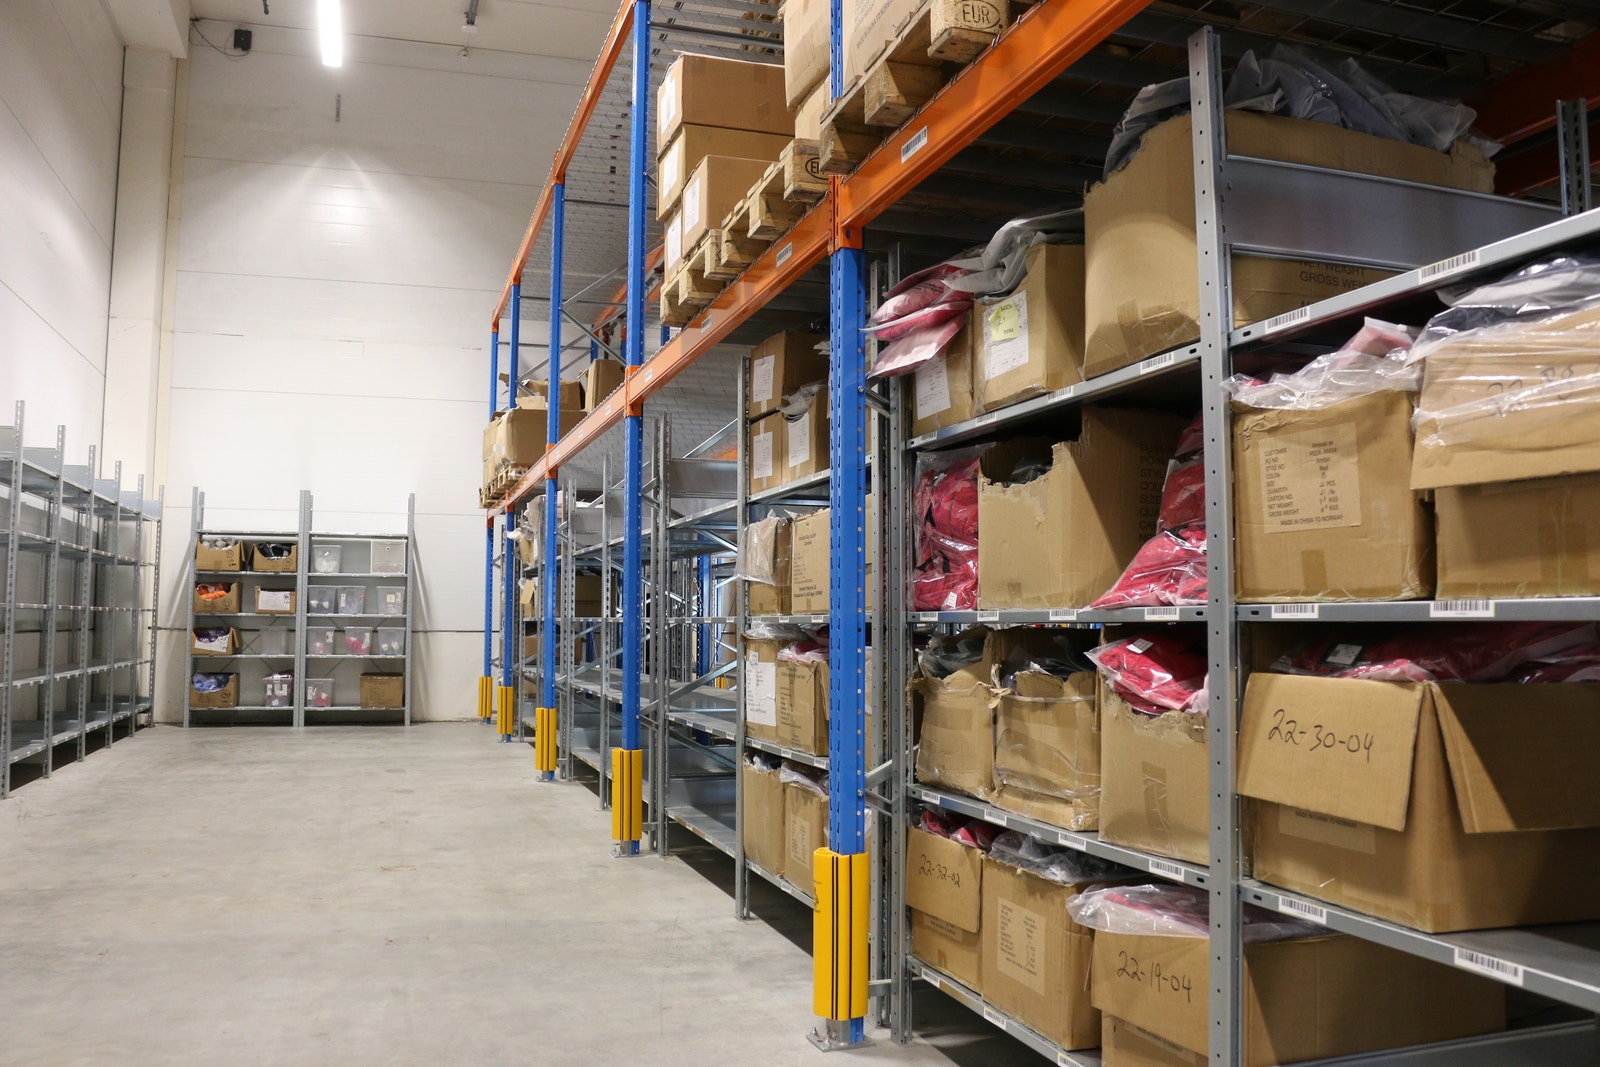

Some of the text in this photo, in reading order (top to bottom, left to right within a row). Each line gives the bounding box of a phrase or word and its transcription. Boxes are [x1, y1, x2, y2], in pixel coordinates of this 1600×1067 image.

[962, 4, 991, 24] EUR
[1300, 271, 1339, 287] GROSS
[1299, 517, 1314, 525] CHINA
[1322, 514, 1344, 522] NORWAY
[1268, 708, 1375, 763] 22-30-04
[1117, 950, 1193, 1004] 22-19-04
